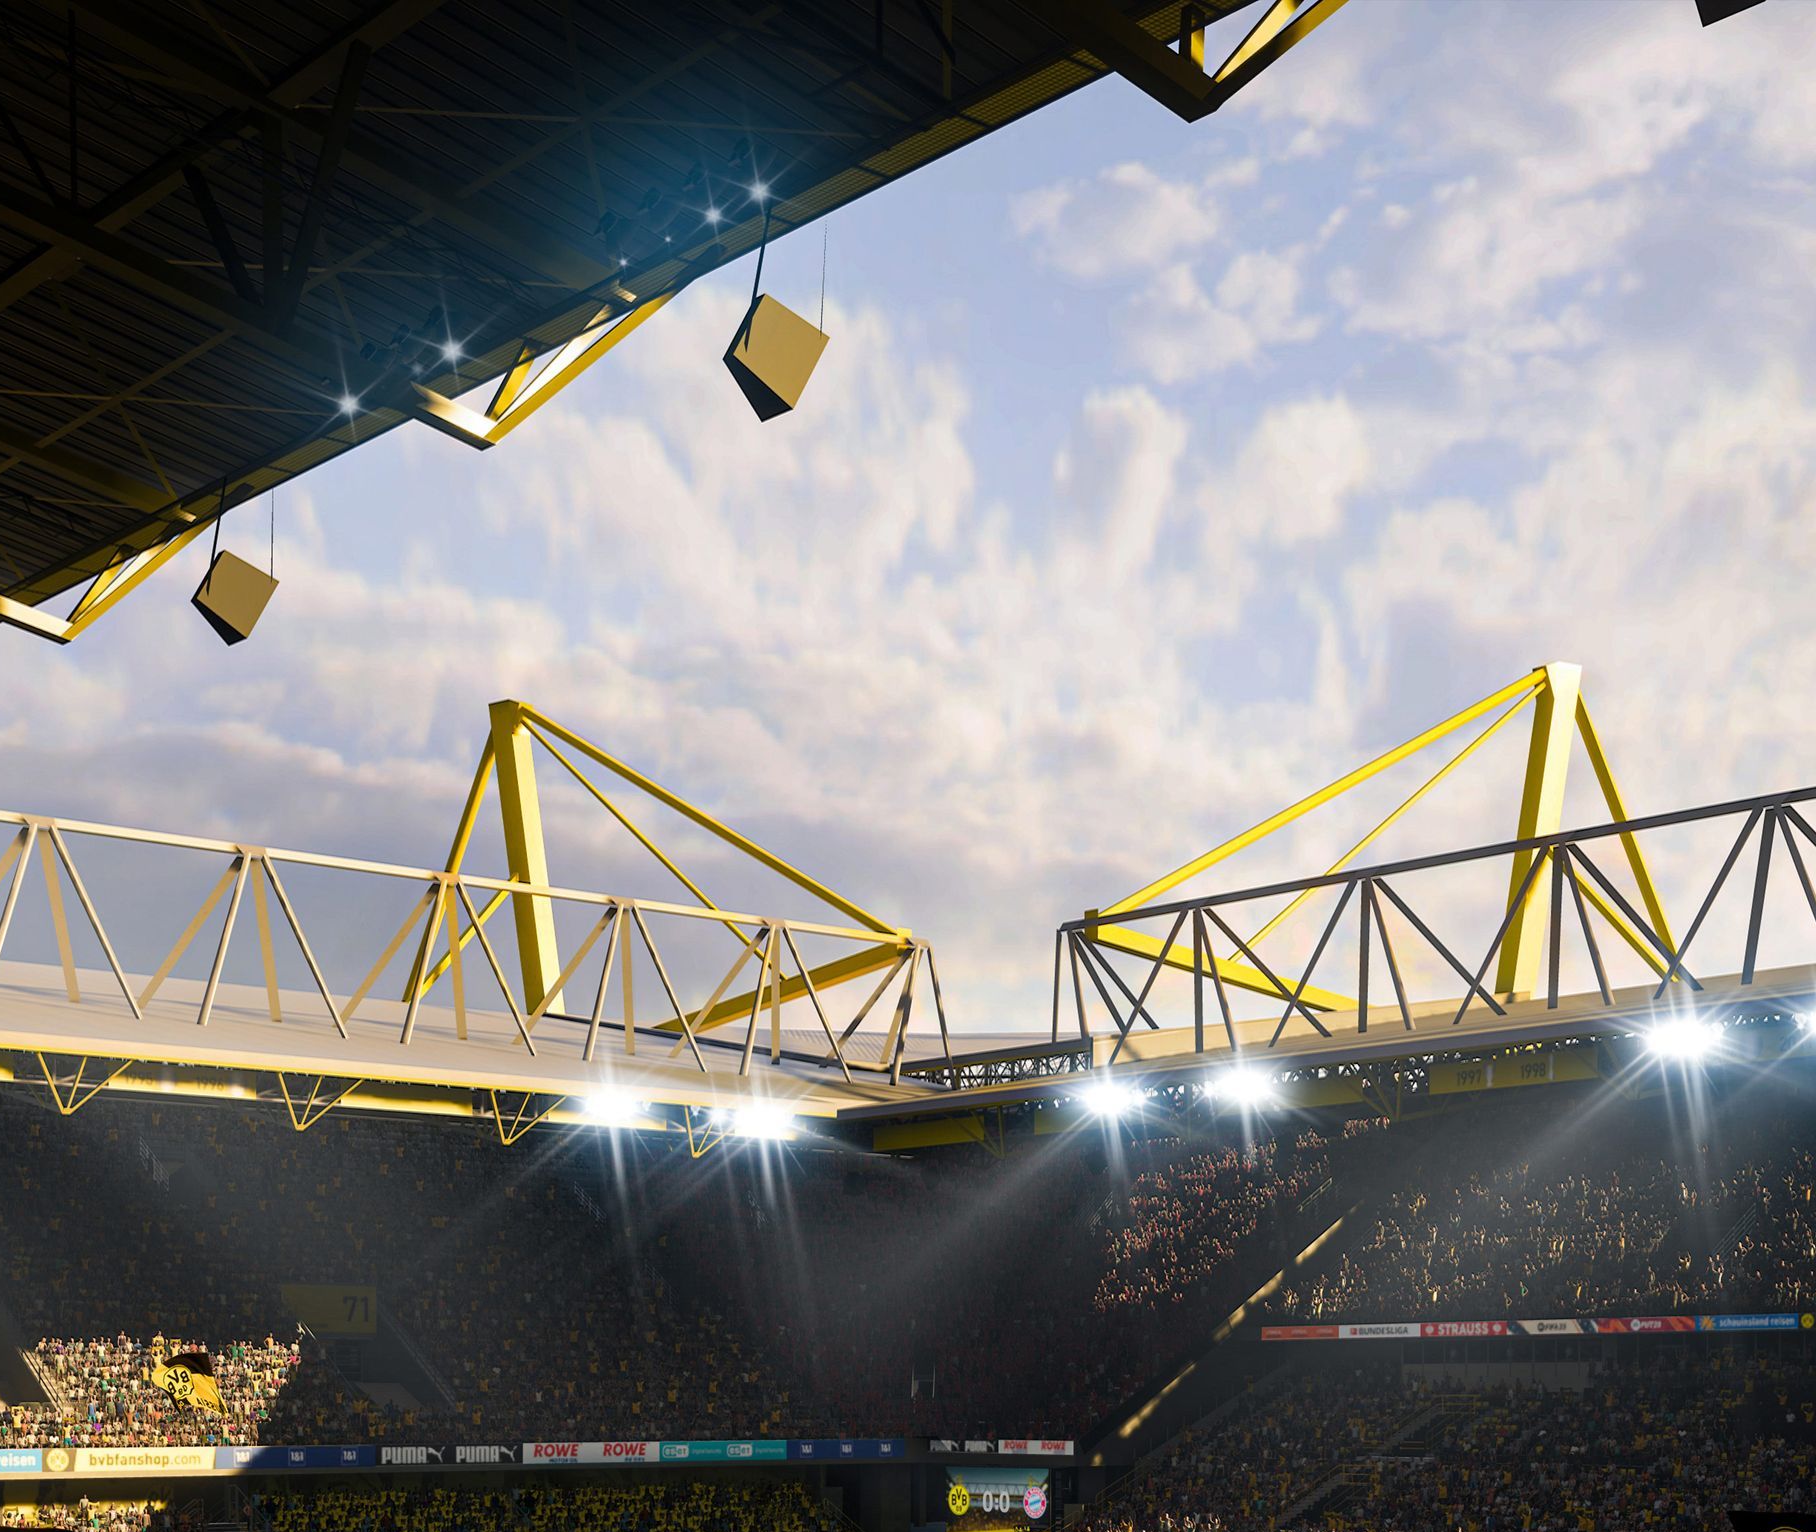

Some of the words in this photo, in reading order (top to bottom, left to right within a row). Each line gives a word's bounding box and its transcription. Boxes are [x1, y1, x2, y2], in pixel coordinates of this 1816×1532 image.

[343, 1296, 370, 1323] 71
[1359, 1327, 1408, 1337] BUNDESLIGA
[1438, 1322, 1489, 1337] STRAUSS
[381, 1446, 427, 1464] PUMA
[456, 1445, 500, 1463] PUMA
[534, 1444, 579, 1457] ROWE
[603, 1443, 646, 1456] ROWE
[89, 1454, 201, 1468] bvbfanshop.com
[951, 1488, 968, 1506] BVB
[982, 1490, 1010, 1513] 0:0
